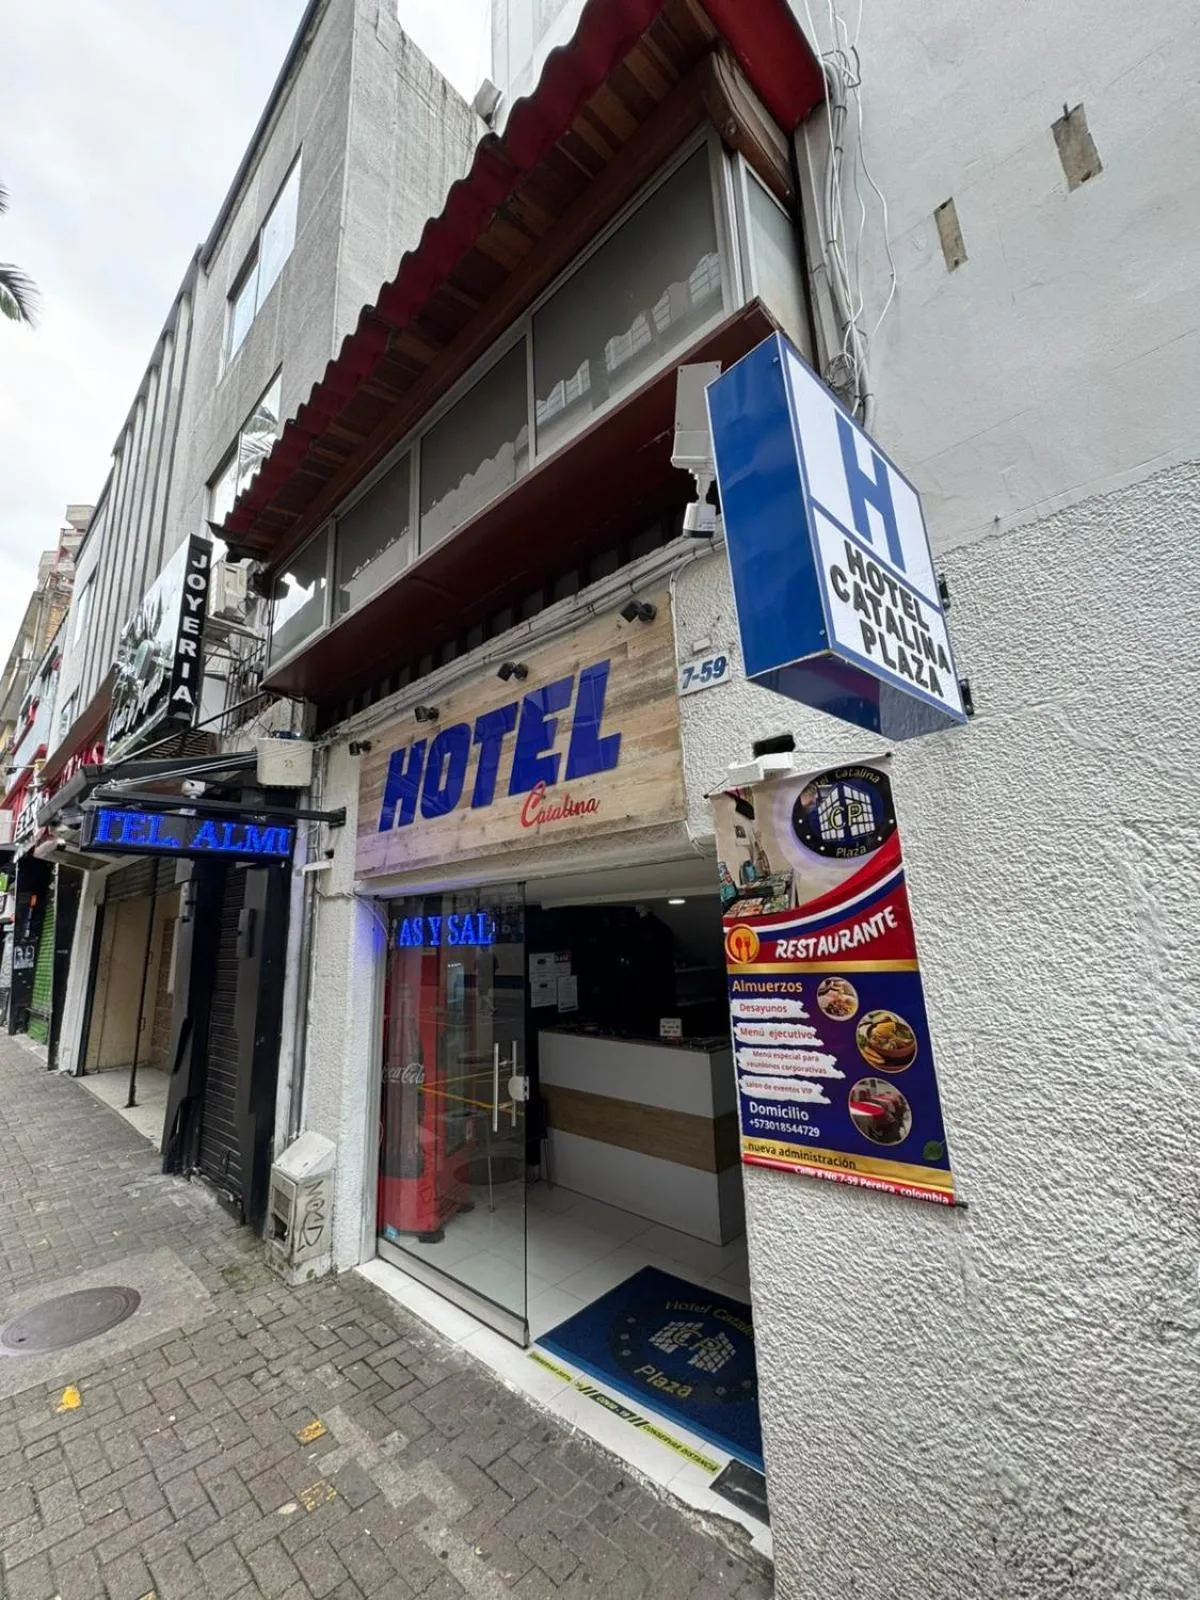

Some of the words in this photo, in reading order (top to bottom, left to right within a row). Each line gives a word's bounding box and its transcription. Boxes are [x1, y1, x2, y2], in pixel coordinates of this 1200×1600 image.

[834, 406, 907, 573] H
[843, 540, 930, 633] HOTEL
[830, 564, 951, 674] CATALINA
[172, 555, 207, 703] JOYERIA
[860, 619, 944, 698] PLAZA
[682, 656, 727, 689] 7-59
[378, 658, 622, 833] HOTEL
[835, 768, 880, 784] Catalina
[520, 780, 600, 829] Catalina
[836, 845, 867, 858] Plaza
[775, 905, 898, 959] RESTAURANTE
[732, 979, 803, 993] Almuerzos
[739, 1003, 788, 1015] Desayunos
[769, 1028, 814, 1040] ejecutivo
[773, 1052, 801, 1062] especial
[803, 1055, 820, 1063] para
[782, 1063, 828, 1075] corporativas
[773, 1085, 800, 1094] eventos
[801, 1086, 814, 1095] VIP
[749, 1101, 810, 1120] Domicilio
[749, 1118, 820, 1137] +573018544729
[748, 1143, 777, 1155] nueva
[779, 1147, 857, 1170] administración
[900, 1187, 950, 1205] colombia
[666, 1300, 712, 1314] Hotel
[633, 1364, 693, 1397] Plaza
